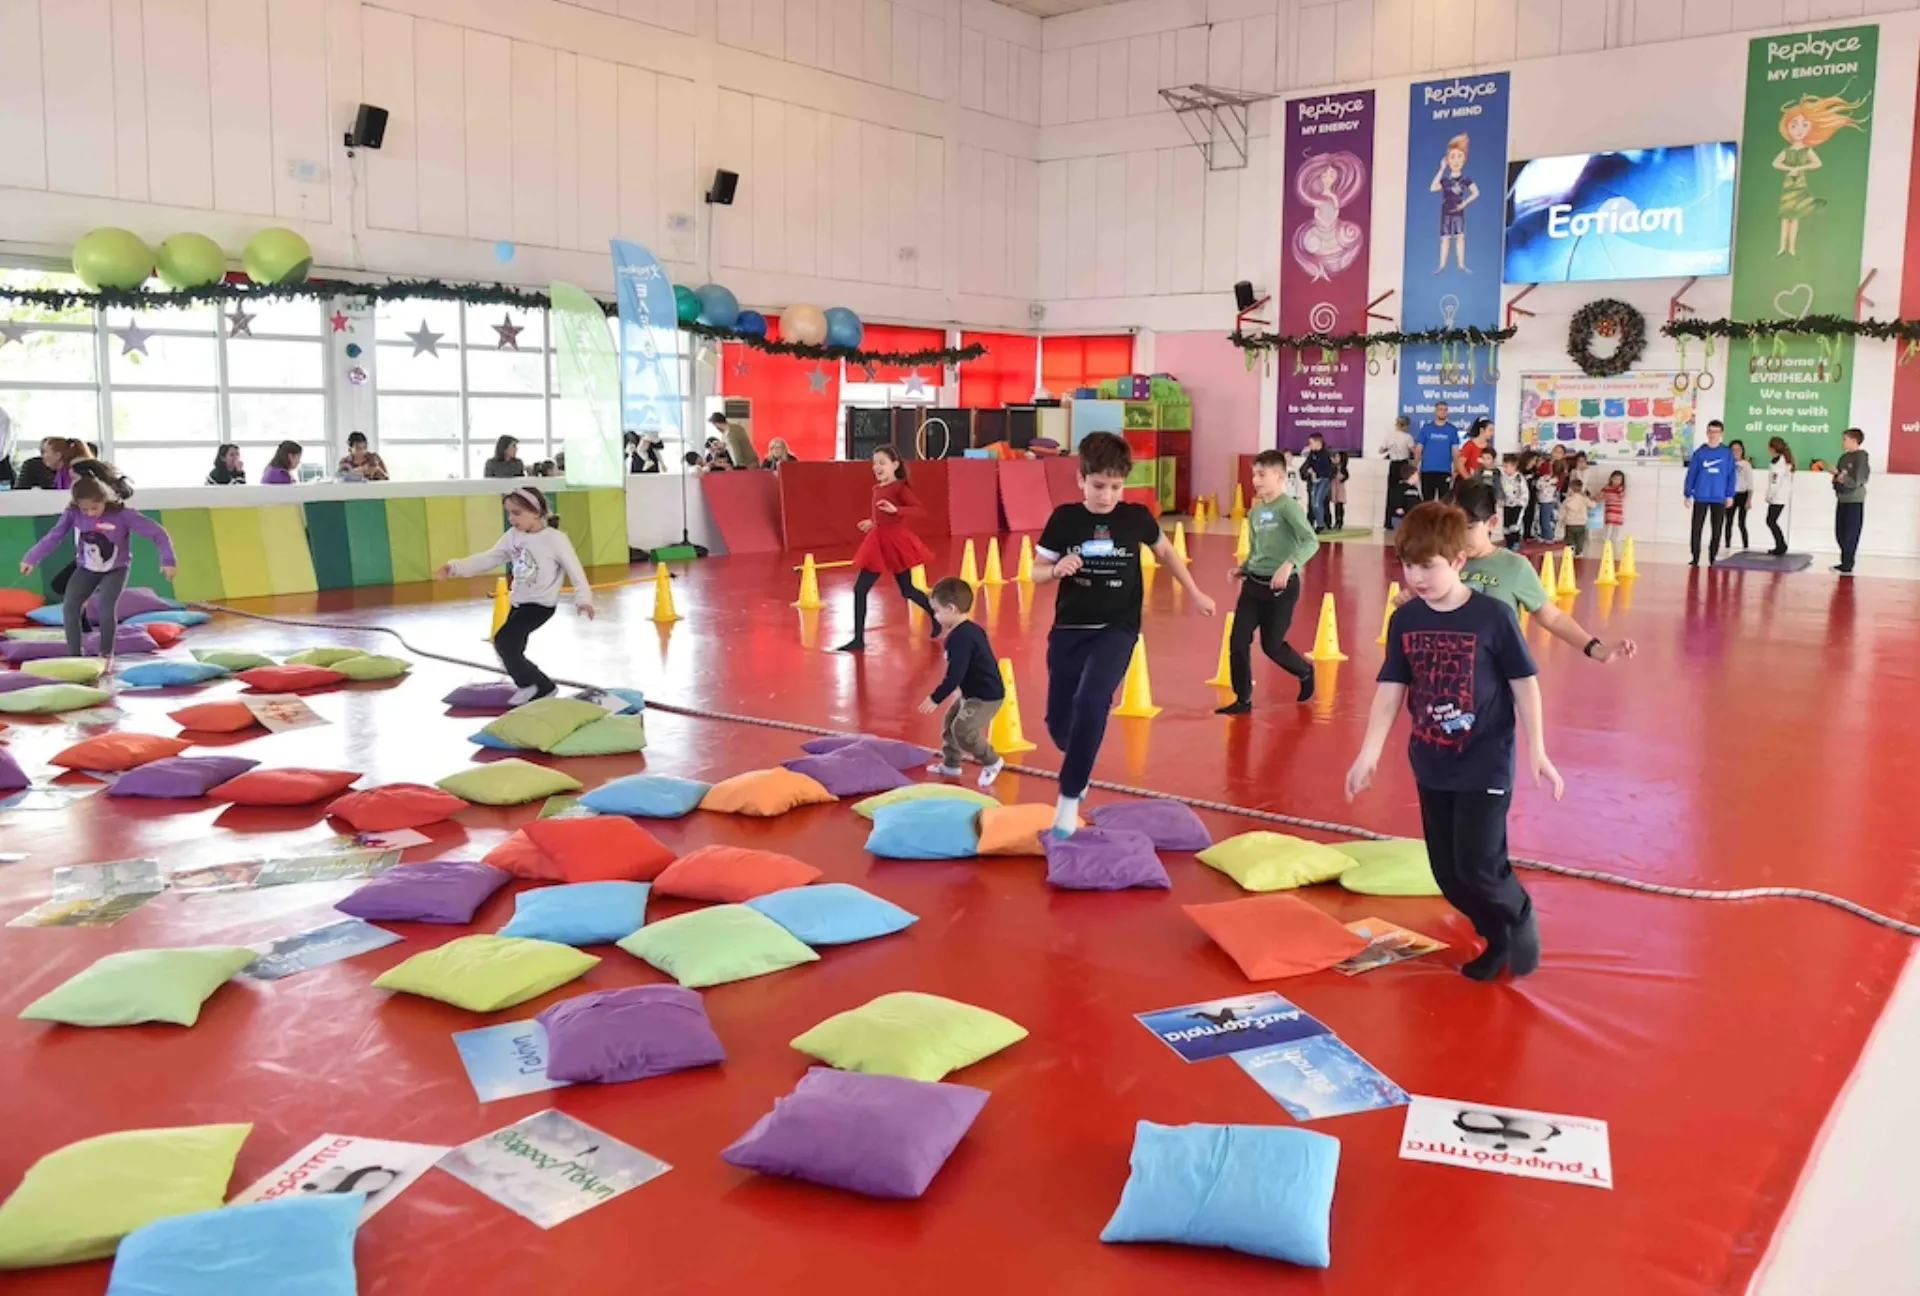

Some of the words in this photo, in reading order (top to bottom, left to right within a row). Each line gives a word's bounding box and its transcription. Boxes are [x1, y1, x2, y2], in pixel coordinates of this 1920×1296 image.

[1768, 33, 1862, 64] Replayce
[1767, 69, 1789, 81] MY
[1791, 62, 1858, 79] EMOTION
[1424, 80, 1498, 105] Replayce
[1298, 96, 1364, 121] Replayce
[1433, 109, 1450, 120] MY
[1453, 105, 1482, 118] MIND
[1301, 125, 1316, 135] MY
[1319, 120, 1360, 133] ENERGY
[1548, 202, 1683, 239] Εστίαση
[1308, 376, 1335, 387] SOUL
[1300, 390, 1316, 400] We
[1318, 390, 1343, 400] train
[1423, 390, 1440, 399] We
[1442, 390, 1469, 399] train
[1760, 388, 1782, 400] We
[1785, 388, 1819, 400] train
[1288, 404, 1298, 413] to
[1300, 404, 1335, 413] vibrate
[1403, 404, 1414, 413] to
[1749, 405, 1762, 416] to
[1766, 405, 1794, 416] love
[1797, 405, 1828, 416] with
[1294, 417, 1347, 428] uniqueness
[1745, 421, 1762, 432] all
[1766, 423, 1789, 432] our
[1792, 422, 1829, 432] heart
[1164, 1009, 1302, 1044] Ανεξαρτησία
[1406, 1139, 1609, 1183] Τρυφερότητα
